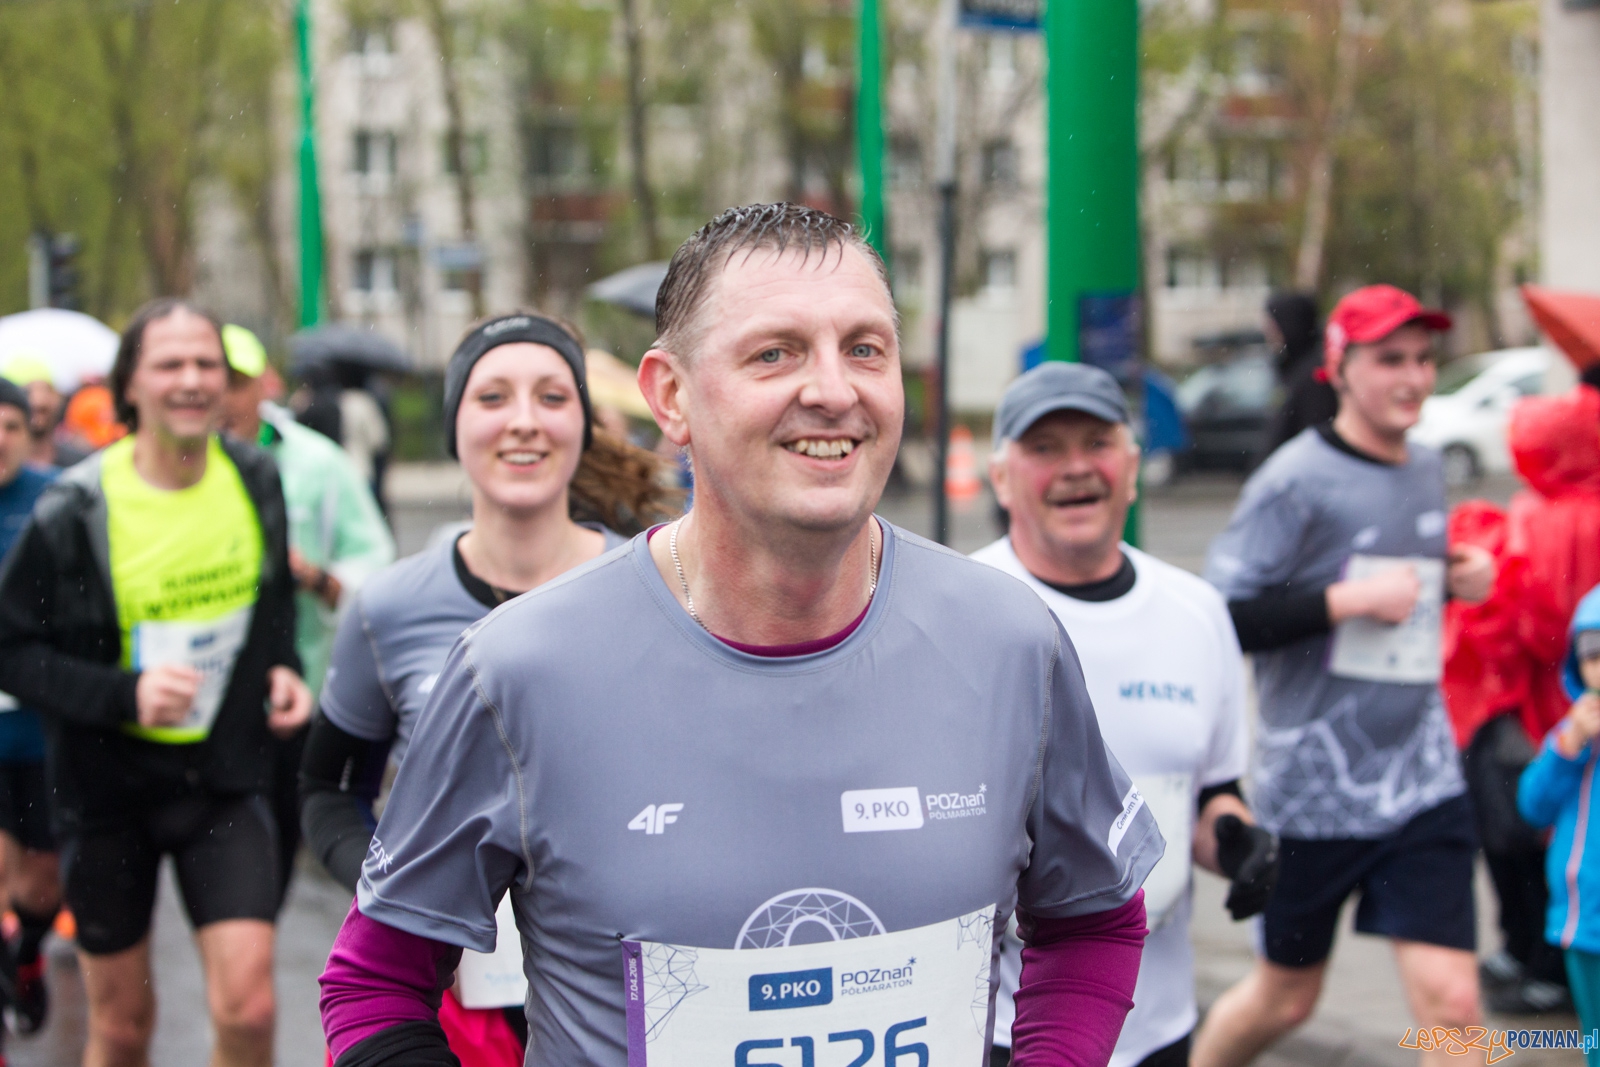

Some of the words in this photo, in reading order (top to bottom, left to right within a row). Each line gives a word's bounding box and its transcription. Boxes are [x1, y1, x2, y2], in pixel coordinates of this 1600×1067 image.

[627, 802, 685, 835] 4F
[873, 800, 910, 819] PKO
[928, 807, 987, 821] PÓŁMARATON
[628, 957, 639, 1001] 17.04.2016
[841, 978, 913, 996] PÓŁMARATON
[780, 979, 821, 999] PKO
